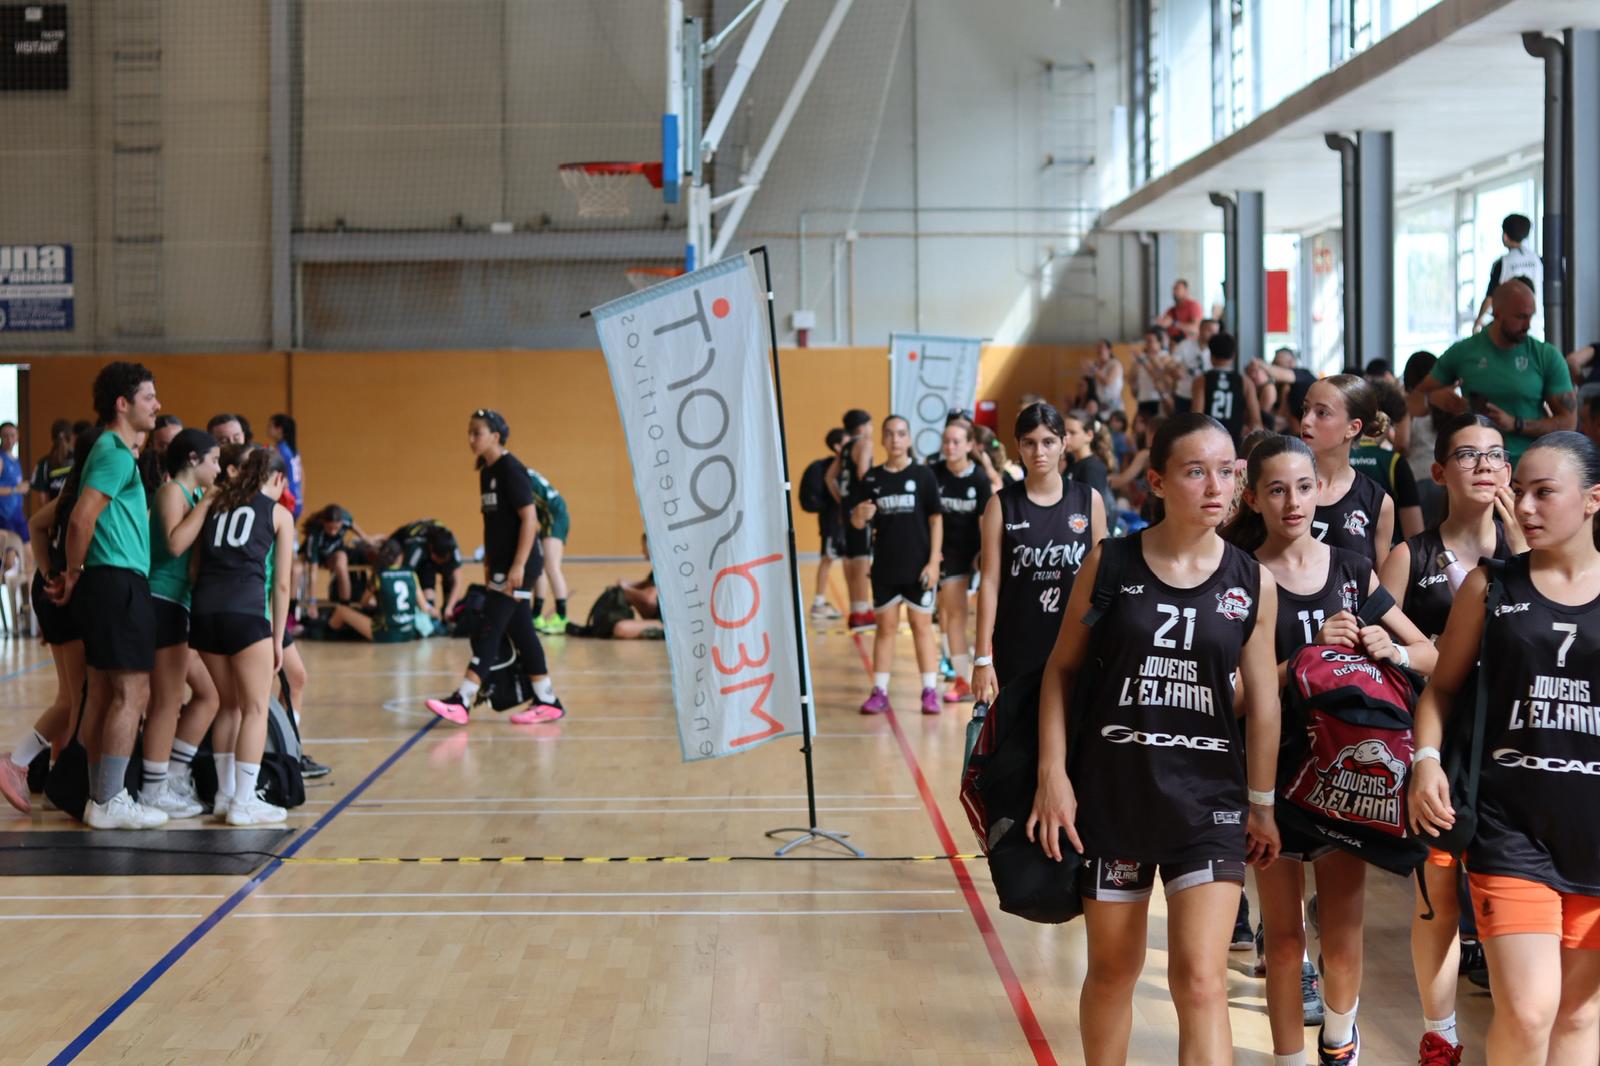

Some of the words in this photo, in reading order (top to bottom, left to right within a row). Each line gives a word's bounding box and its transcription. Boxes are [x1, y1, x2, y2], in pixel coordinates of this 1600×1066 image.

[1212, 390, 1233, 419] 21
[213, 506, 255, 547] 10
[1312, 520, 1329, 542] 7
[1011, 539, 1086, 577] JOVENS
[393, 580, 410, 611] 2
[1040, 587, 1061, 612] 42
[1153, 603, 1197, 651] 21
[1298, 610, 1325, 645] 11
[1552, 622, 1577, 668] 7
[1138, 655, 1198, 683] JOVENS
[1529, 675, 1591, 703] JOVENS
[1101, 724, 1230, 753] SOCAGE
[1492, 748, 1600, 776] SOCAG
[1331, 769, 1386, 797] JOVENS
